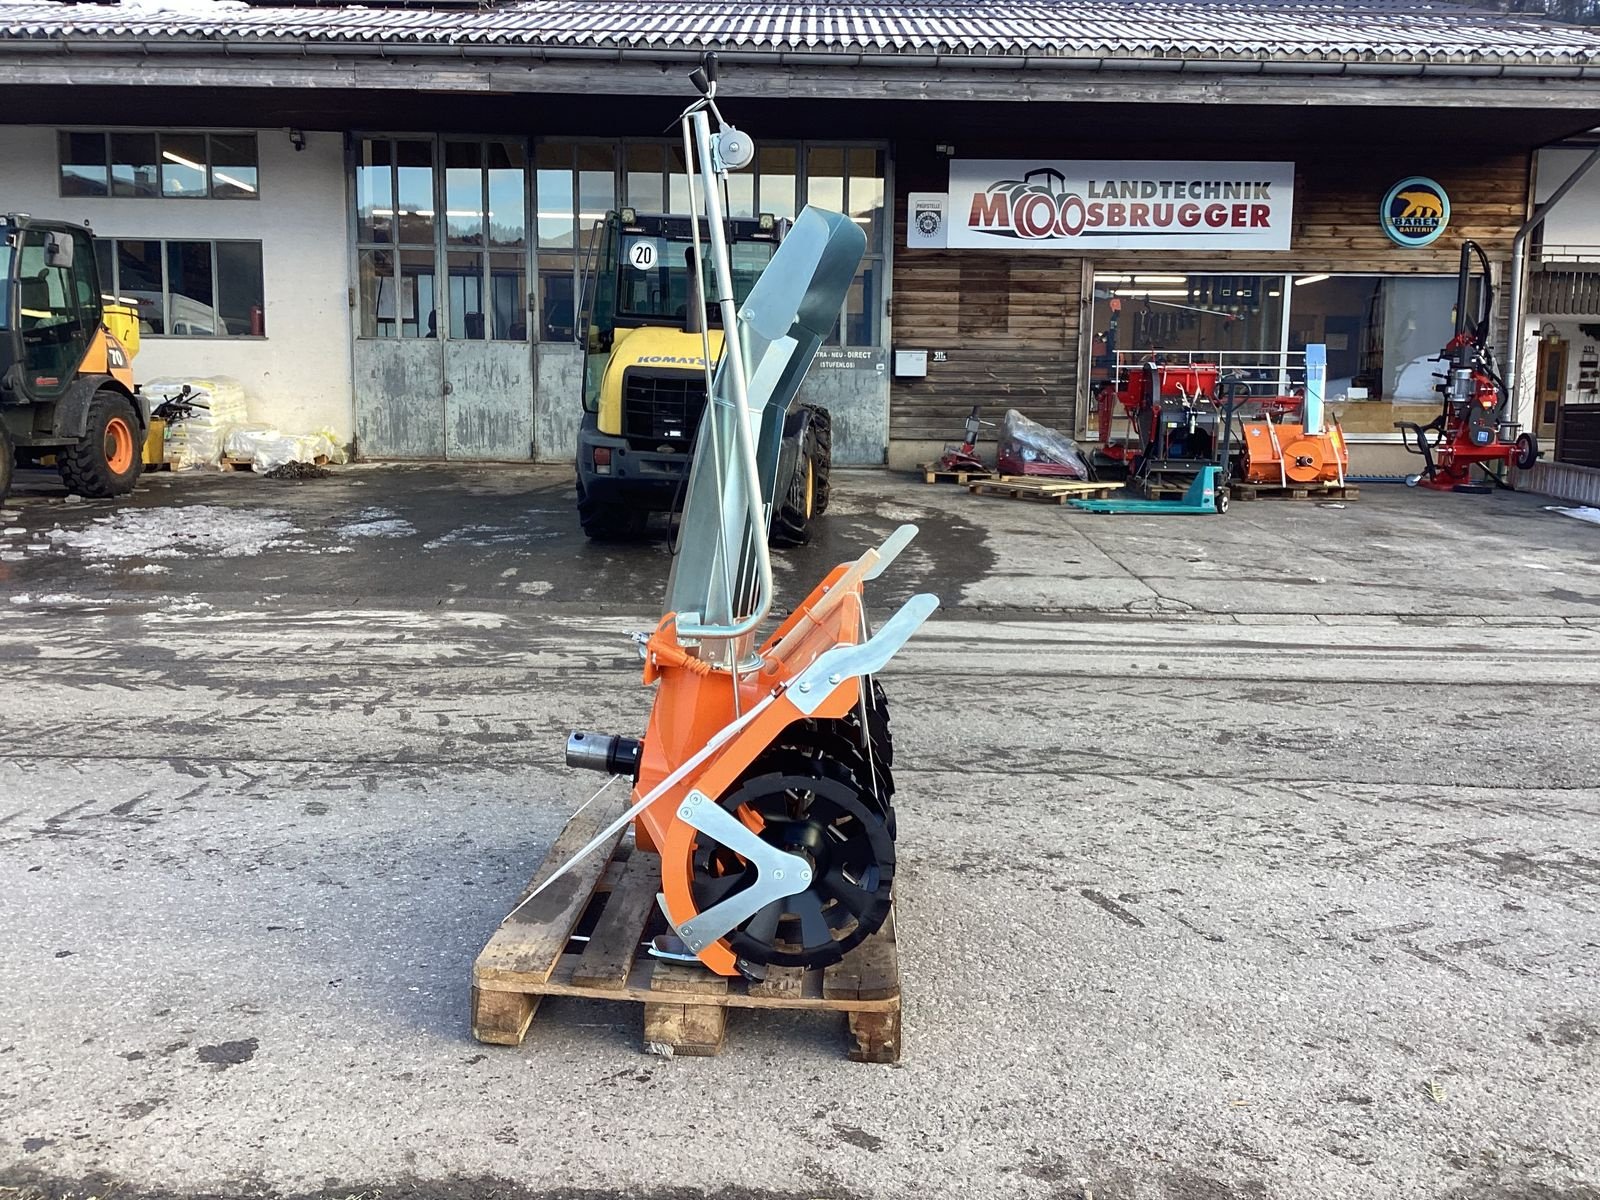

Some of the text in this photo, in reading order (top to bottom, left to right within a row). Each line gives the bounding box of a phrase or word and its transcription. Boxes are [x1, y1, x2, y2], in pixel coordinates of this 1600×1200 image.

[1088, 180, 1272, 200] LANDTECHNIK
[635, 246, 652, 264] 20
[108, 349, 124, 366] 70
[847, 351, 872, 359] DIRECT
